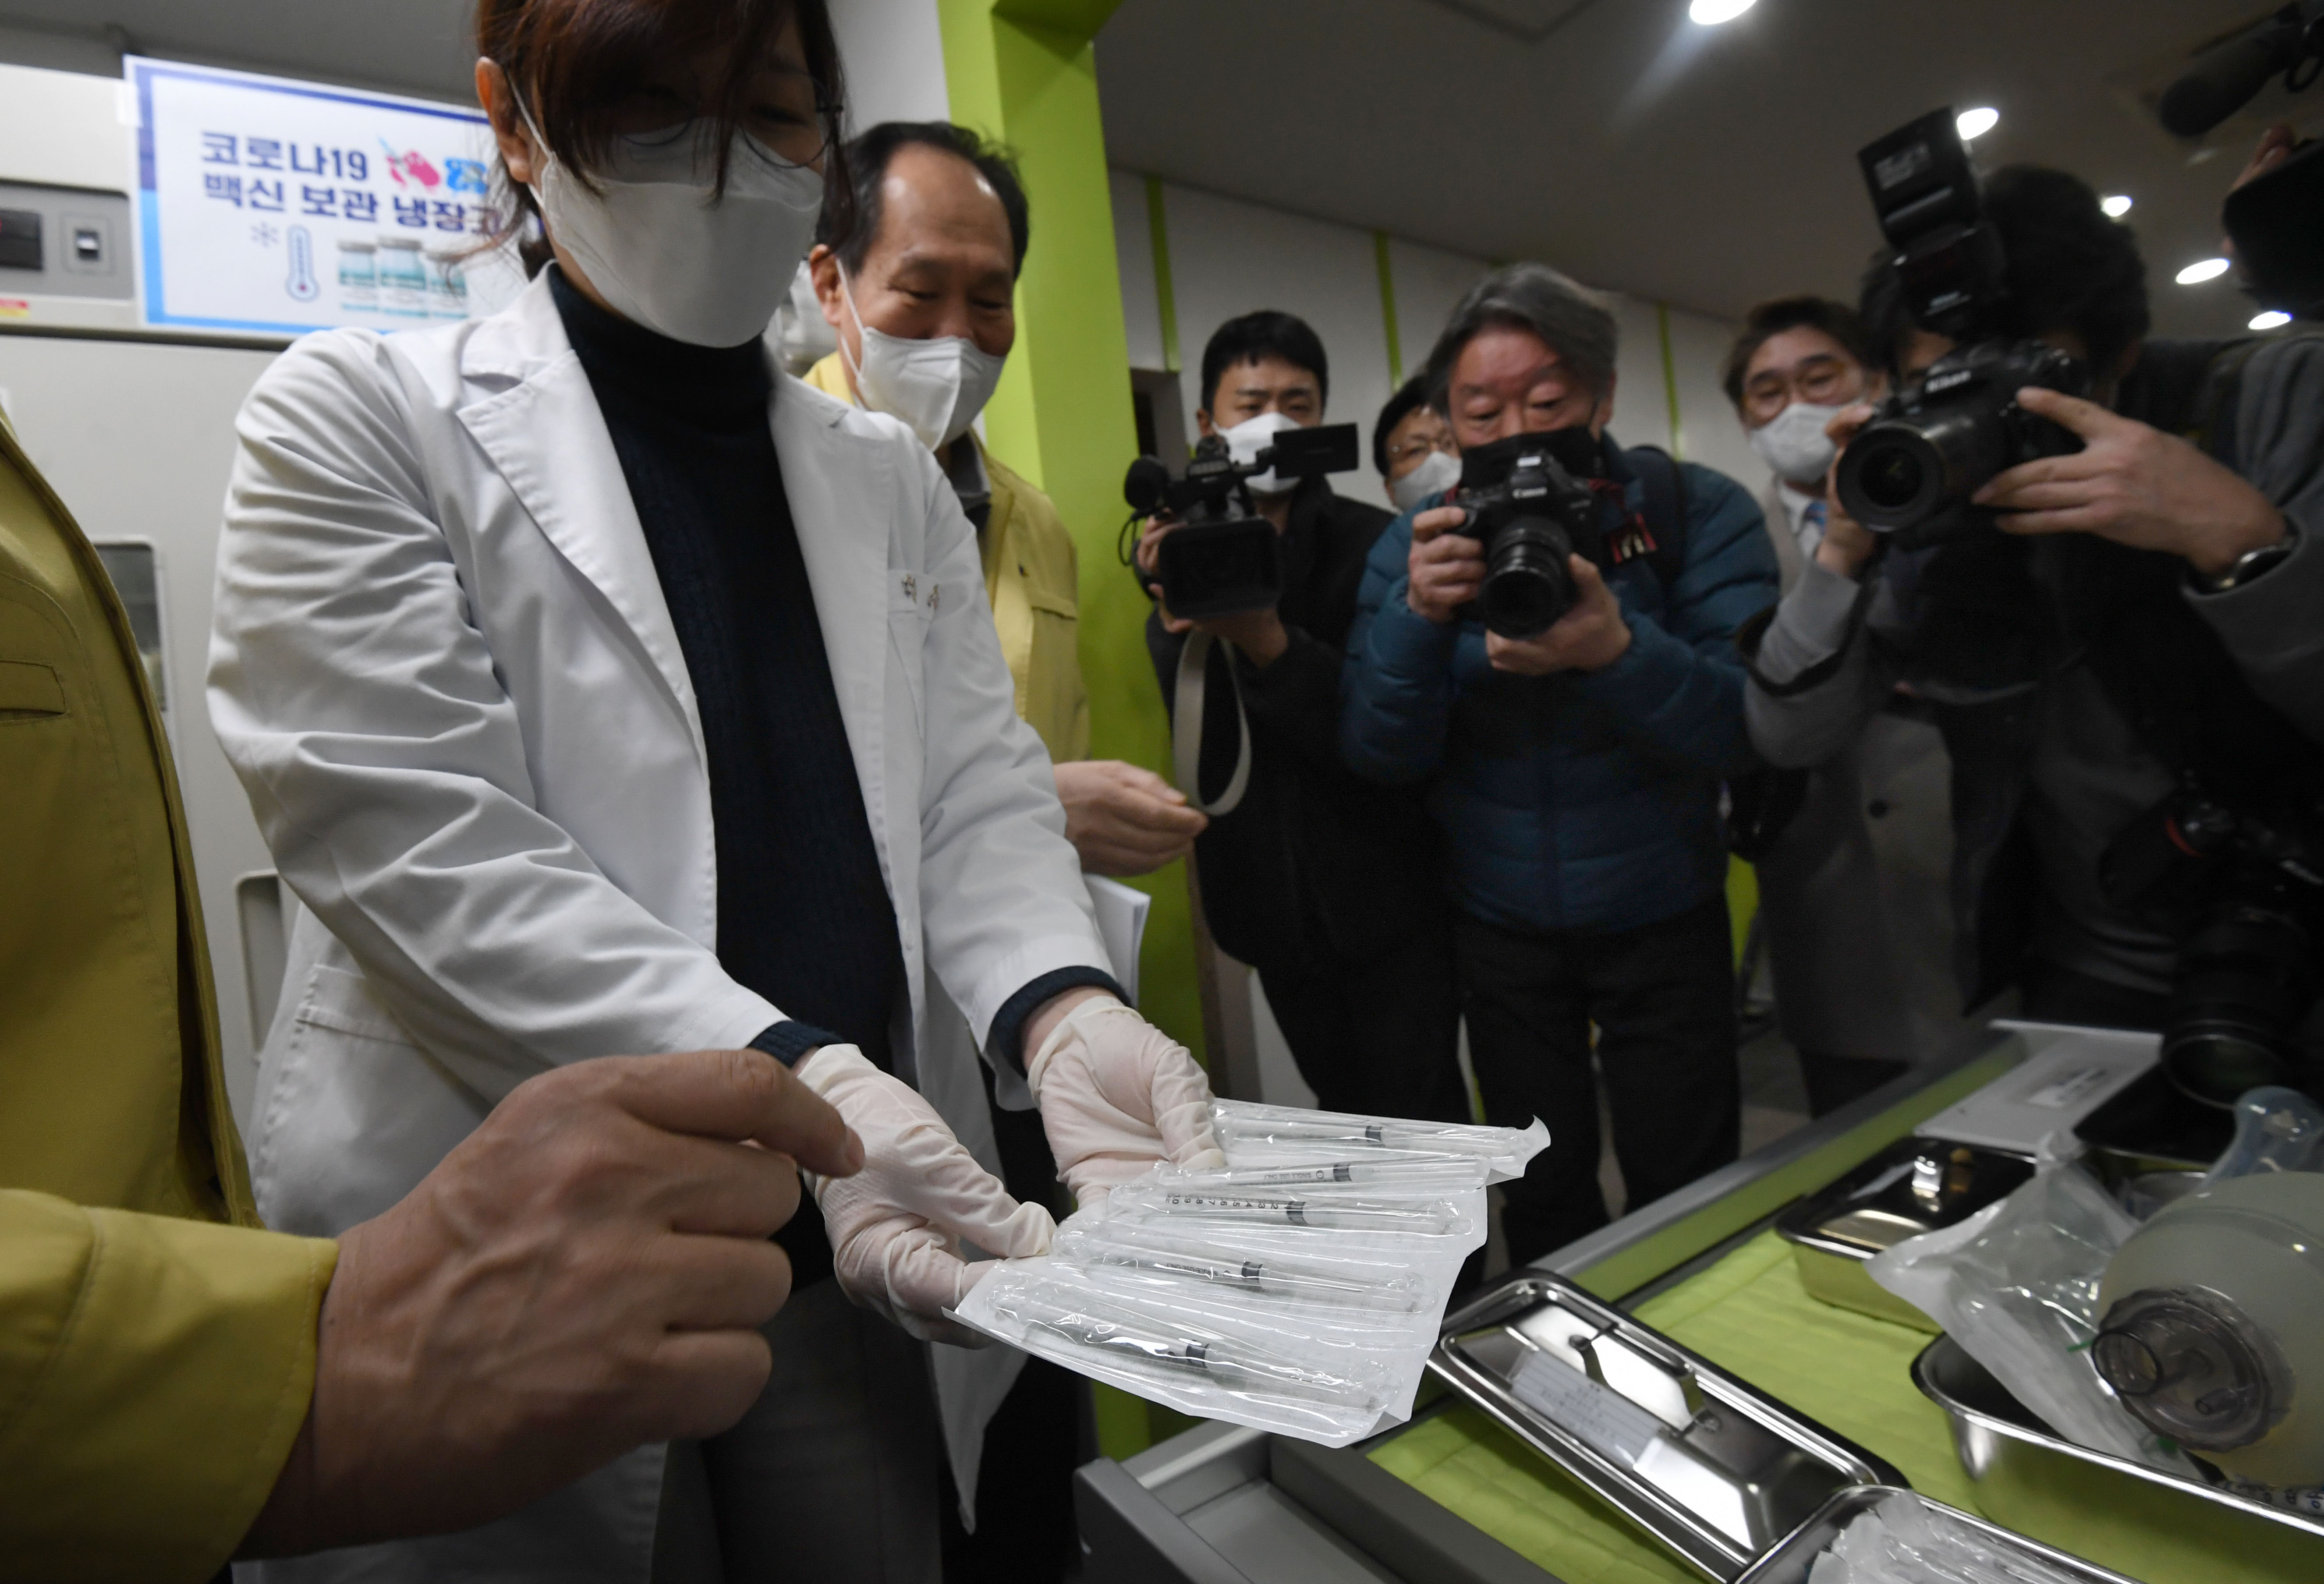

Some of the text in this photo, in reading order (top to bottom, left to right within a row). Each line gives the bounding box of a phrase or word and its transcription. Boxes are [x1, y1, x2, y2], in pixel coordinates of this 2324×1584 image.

[202, 131, 368, 181] 코로나19
[204, 173, 284, 213] 백신
[301, 184, 378, 223] 보관
